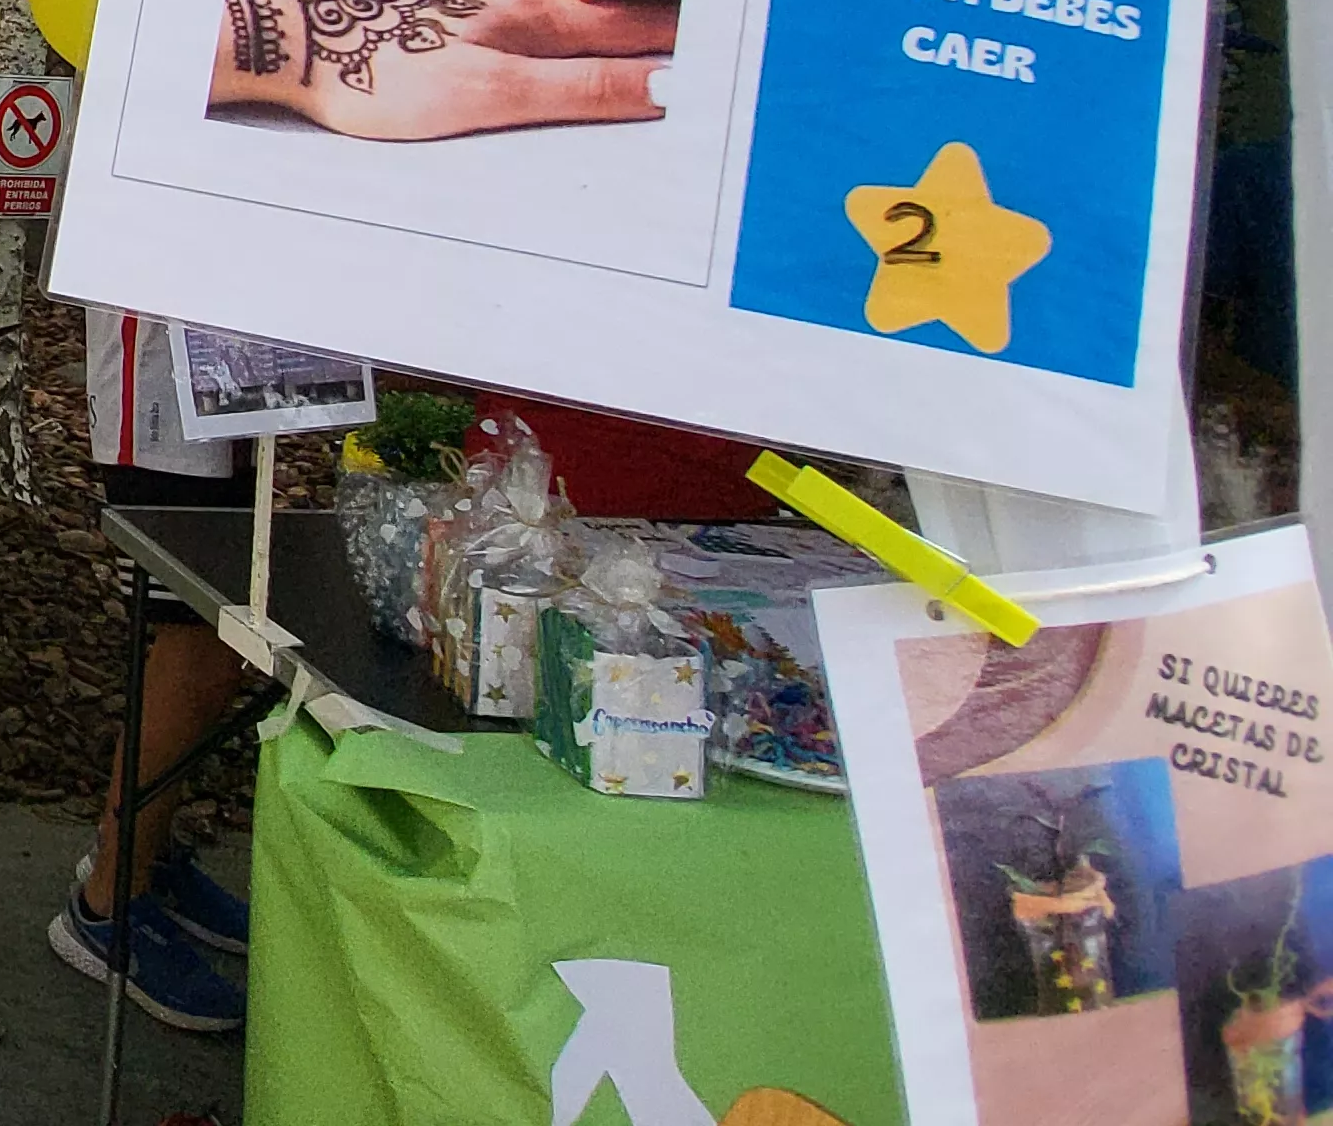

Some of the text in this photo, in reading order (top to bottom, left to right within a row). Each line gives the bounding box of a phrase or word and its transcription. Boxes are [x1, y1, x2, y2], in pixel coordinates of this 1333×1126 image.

[901, 25, 1038, 84] CAER
[3, 201, 42, 211] PERROS
[5, 189, 49, 200] ENTRADA
[883, 201, 942, 265] 2
[1157, 653, 1318, 721] SI QUIERES
[1145, 692, 1324, 763] MACETAS DE
[1170, 742, 1288, 798] CRISTAL
